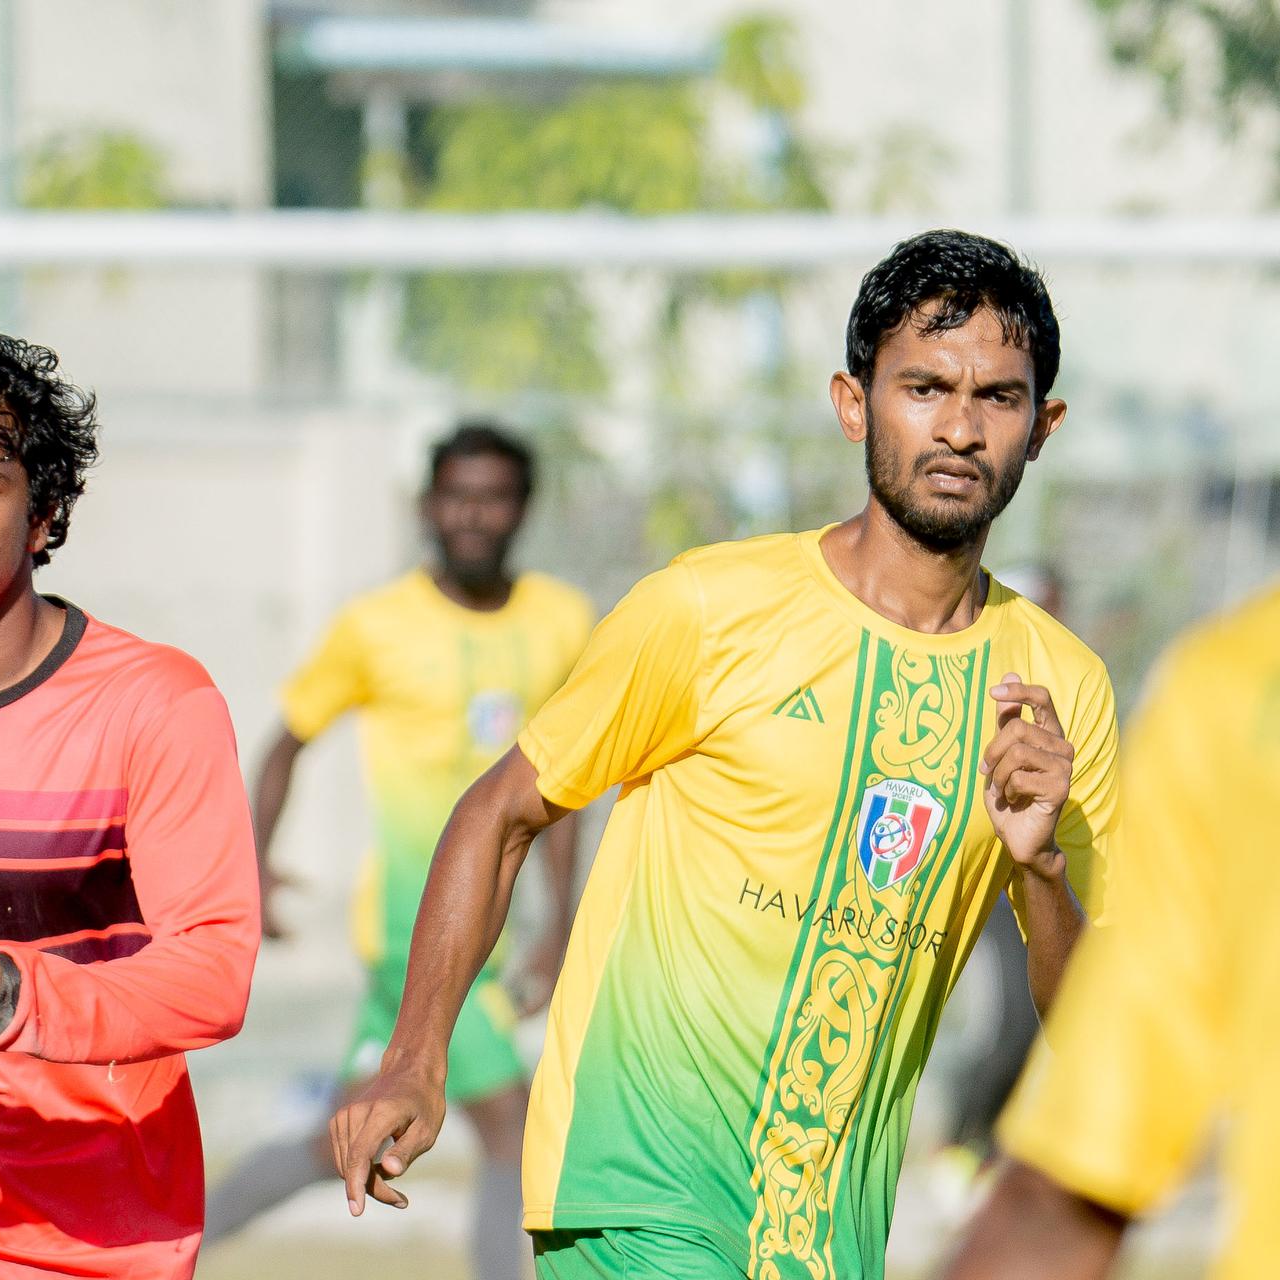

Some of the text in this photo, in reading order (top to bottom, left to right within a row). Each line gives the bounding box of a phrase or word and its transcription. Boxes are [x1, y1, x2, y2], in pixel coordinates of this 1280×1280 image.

[885, 780, 924, 798] HAVARU
[891, 791, 913, 802] SPORTS
[738, 878, 876, 939] HAVARU
